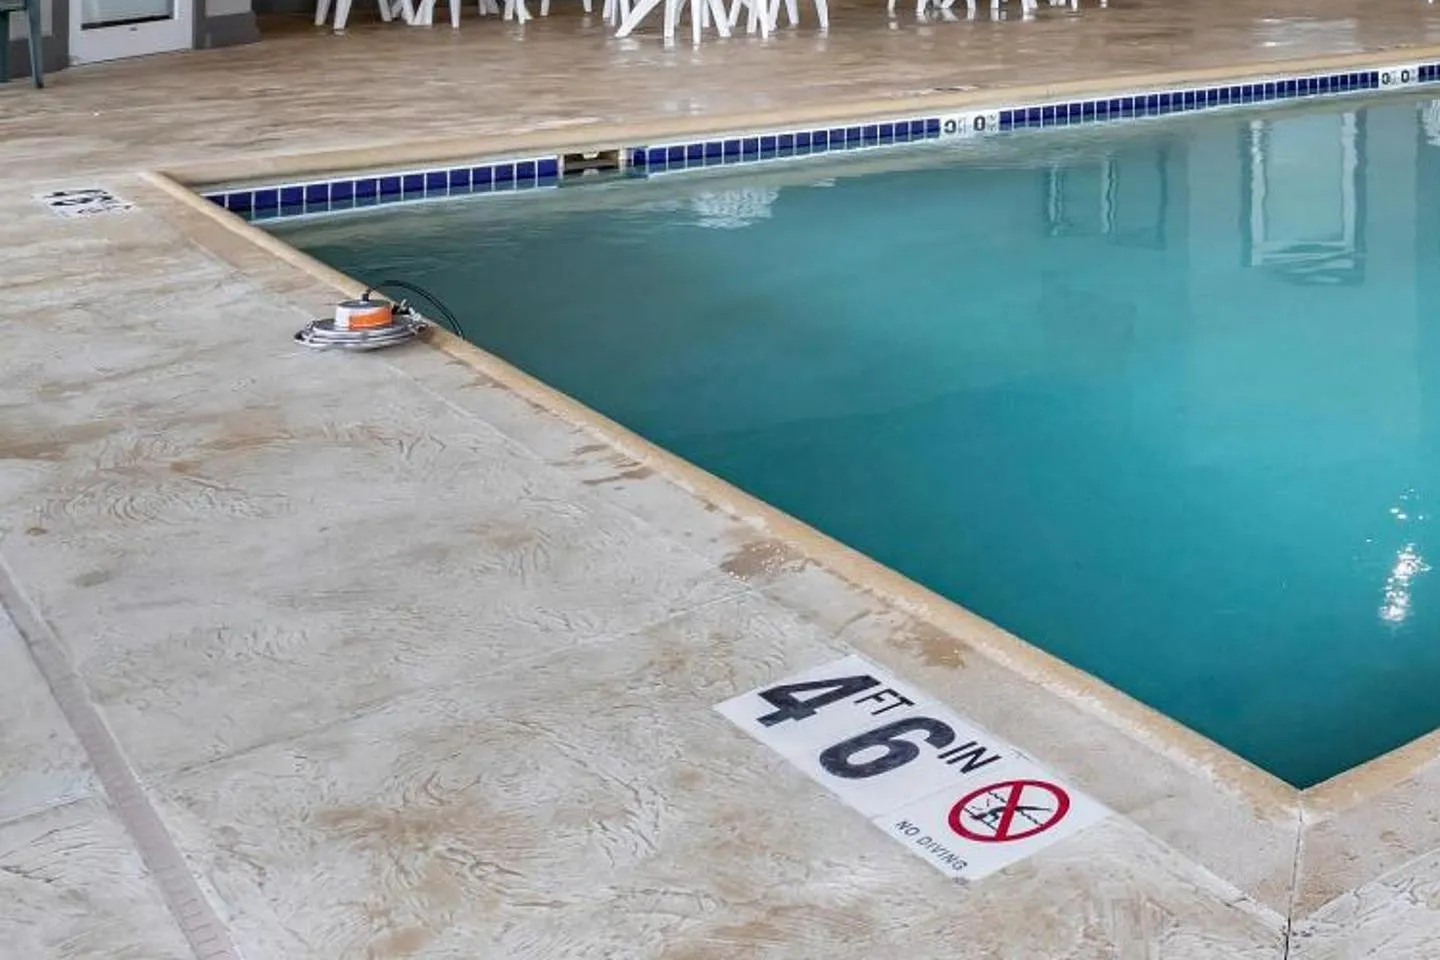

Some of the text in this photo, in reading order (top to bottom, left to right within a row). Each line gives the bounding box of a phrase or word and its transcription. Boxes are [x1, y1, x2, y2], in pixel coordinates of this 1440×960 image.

[756, 674, 916, 727] 4 FT
[819, 717, 1001, 779] 6 IN
[896, 820, 968, 871] NO DIVING
